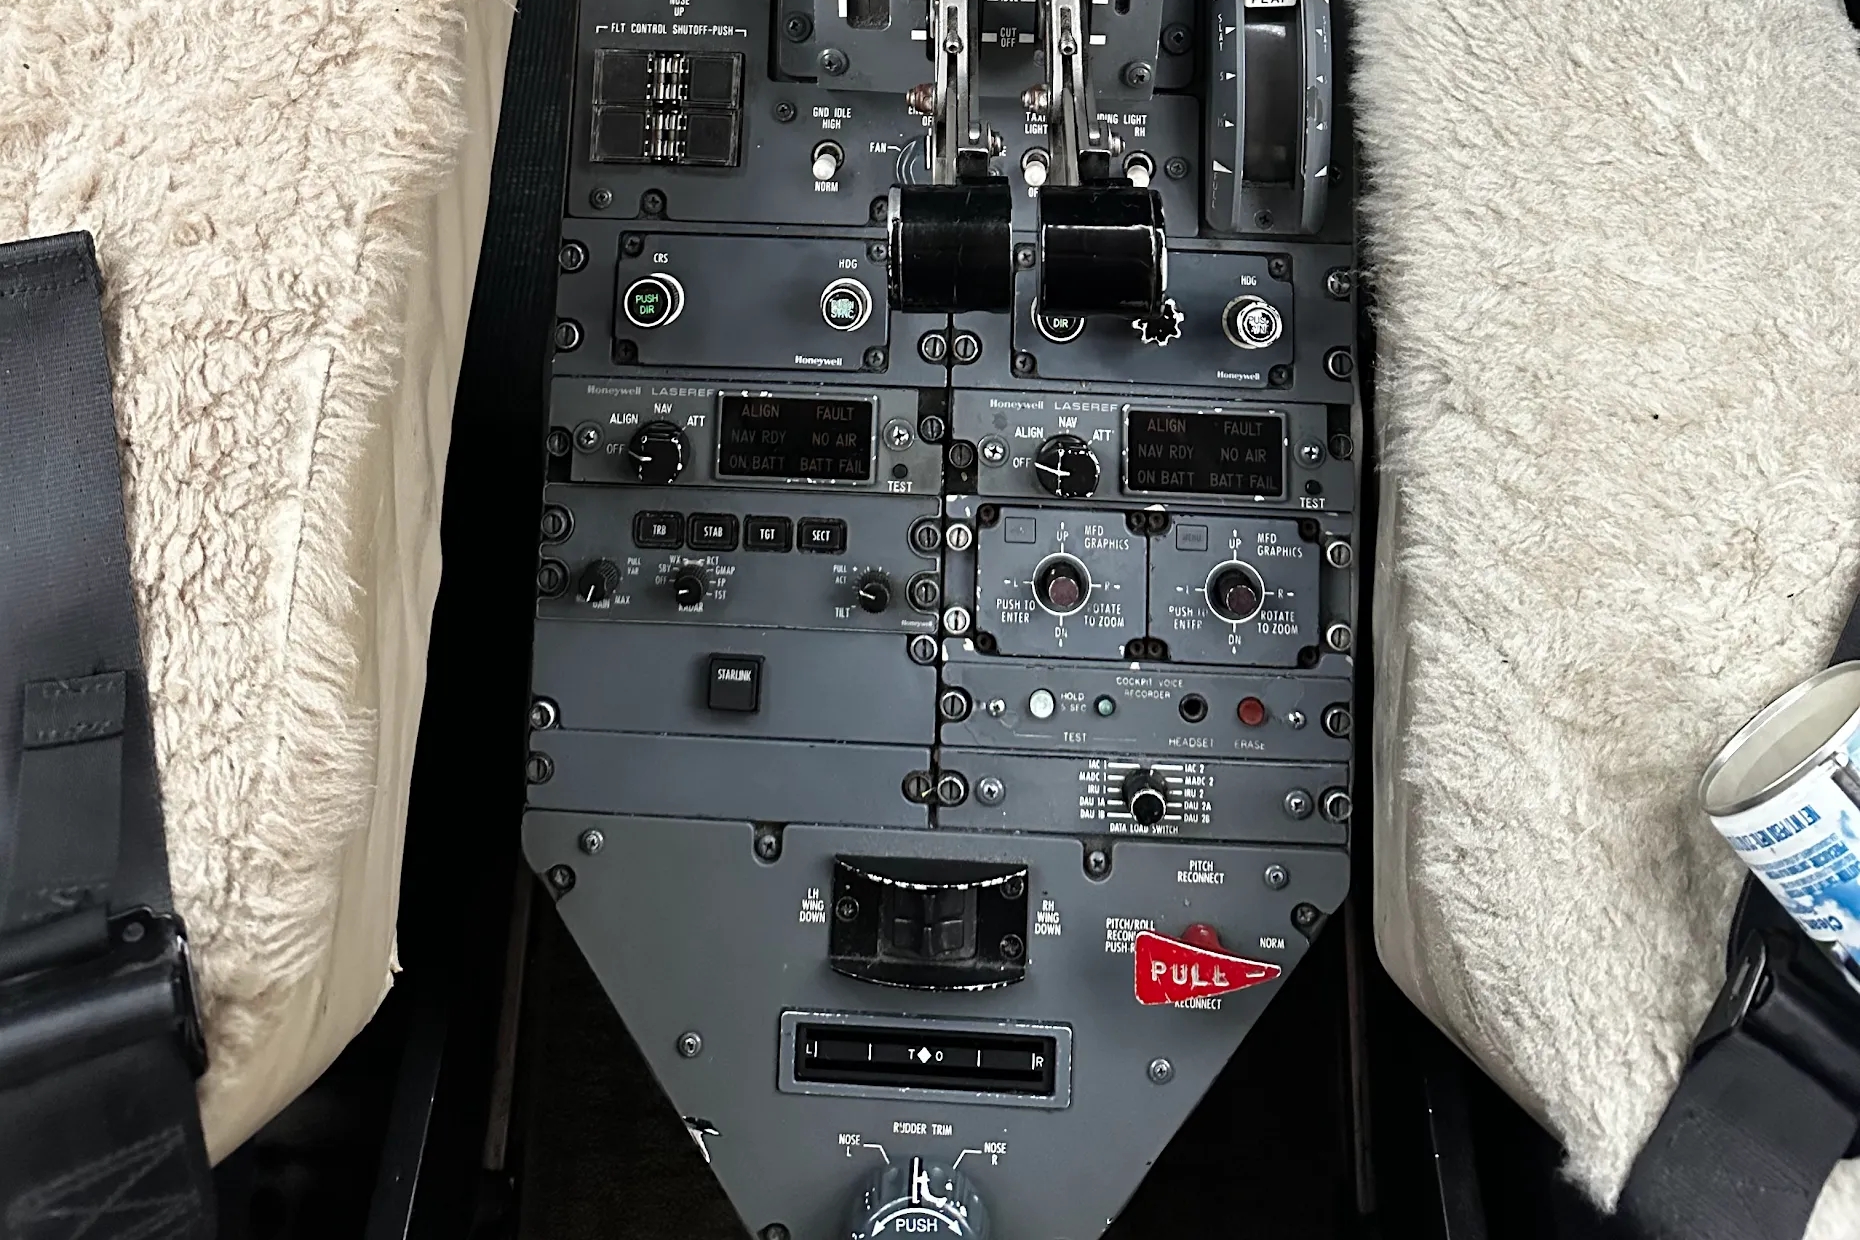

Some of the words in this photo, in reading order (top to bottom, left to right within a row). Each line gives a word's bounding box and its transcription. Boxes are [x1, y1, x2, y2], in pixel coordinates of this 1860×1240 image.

[611, 23, 625, 32] FLT
[631, 23, 667, 34] CONTROL
[673, 24, 733, 35] SHUTOFF-PUSH
[813, 107, 829, 117] GND
[834, 108, 851, 118] IDLE
[823, 119, 840, 129] HIGH
[1025, 124, 1048, 134] LIGHT
[870, 142, 886, 153] FAN
[815, 181, 838, 191] NORM
[654, 253, 668, 263] CRS
[839, 259, 857, 269] HDG
[636, 294, 658, 303] PUSH
[640, 305, 654, 314] DIR
[795, 356, 842, 366] Honeywell
[654, 403, 672, 413] NAV
[990, 399, 1043, 410] Honeywell
[1055, 402, 1117, 412] LASEREF
[610, 413, 638, 424] ALIGN
[817, 406, 854, 420] FAULT
[687, 416, 705, 426] ATT
[1148, 418, 1185, 432] ALIGN
[812, 432, 829, 445] NO
[836, 434, 856, 446] AIR
[1013, 457, 1031, 468] OFF
[888, 481, 912, 492] TEST
[653, 525, 666, 535] TRB
[704, 526, 722, 537] STAB
[760, 529, 774, 539] TGT
[813, 530, 830, 541] SECT
[1085, 525, 1103, 536] MFD
[1085, 538, 1129, 550] GRAPHICS
[1002, 612, 1029, 623] ENTER
[1261, 611, 1294, 622] ROTATE
[1258, 623, 1269, 633] TO
[1272, 623, 1298, 634] ZOOM
[718, 669, 751, 681] STARLINK
[1064, 732, 1085, 742] TEST
[1169, 737, 1213, 747] HEADSET
[1110, 823, 1127, 832] DATA
[1152, 825, 1178, 834] SWITCH
[1190, 860, 1213, 871] PITCH
[1178, 871, 1224, 884] RECONNECT
[808, 888, 819, 899] LH
[802, 899, 824, 911] WING
[800, 911, 825, 923] DOWN
[1106, 918, 1155, 932] PITCH/ROLL
[1260, 938, 1284, 948] NORM
[1151, 961, 1229, 987] PULL
[932, 1124, 952, 1135] TRIM
[839, 1134, 860, 1145] NOSE
[896, 1218, 937, 1232] PUSH
